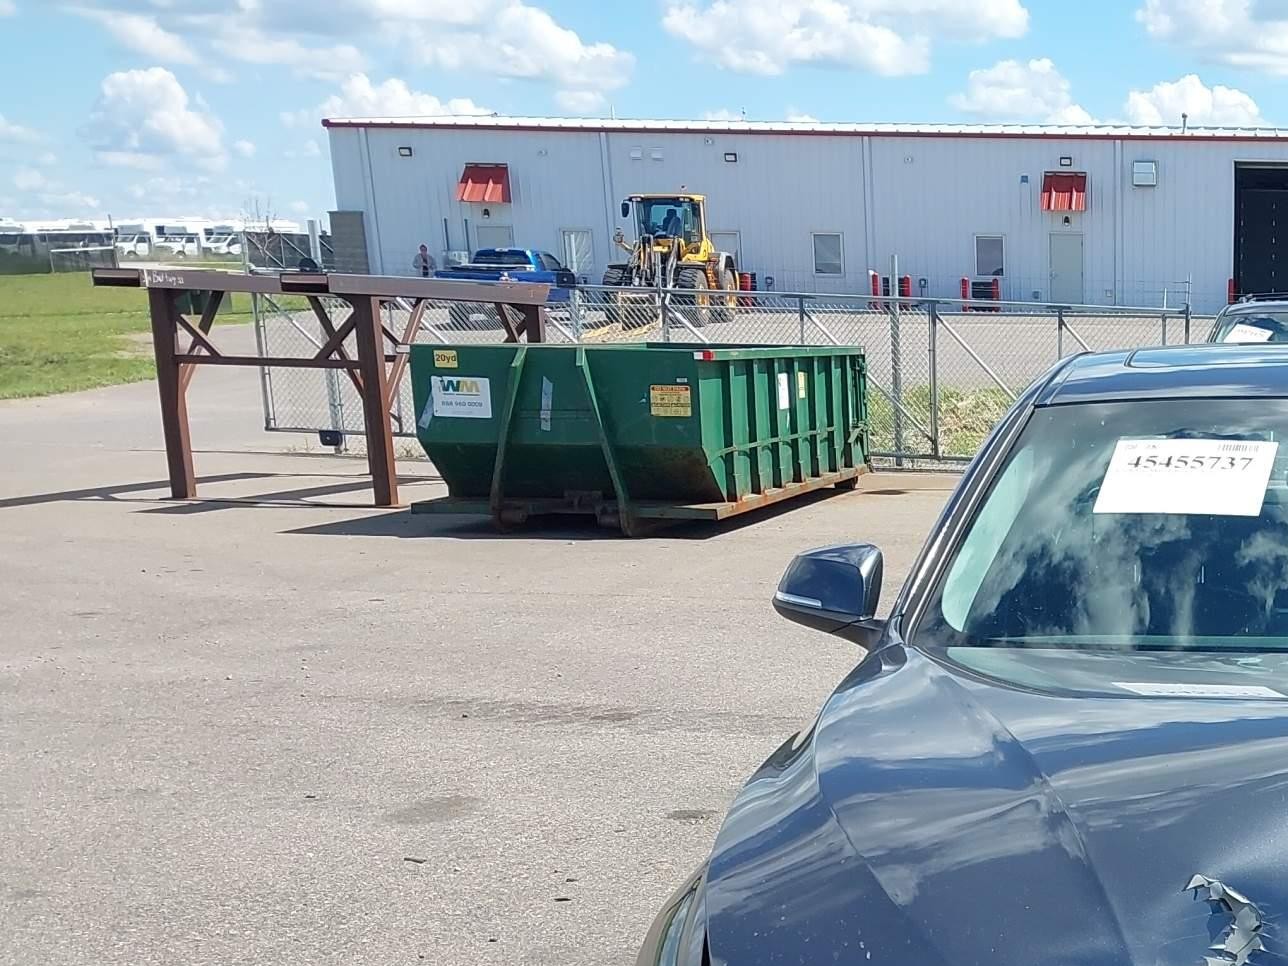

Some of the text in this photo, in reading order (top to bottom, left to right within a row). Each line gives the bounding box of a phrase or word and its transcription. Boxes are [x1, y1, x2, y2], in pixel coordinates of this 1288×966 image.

[435, 353, 457, 363] 20yd
[439, 379, 480, 393] WM
[1128, 455, 1253, 470] 45455737
